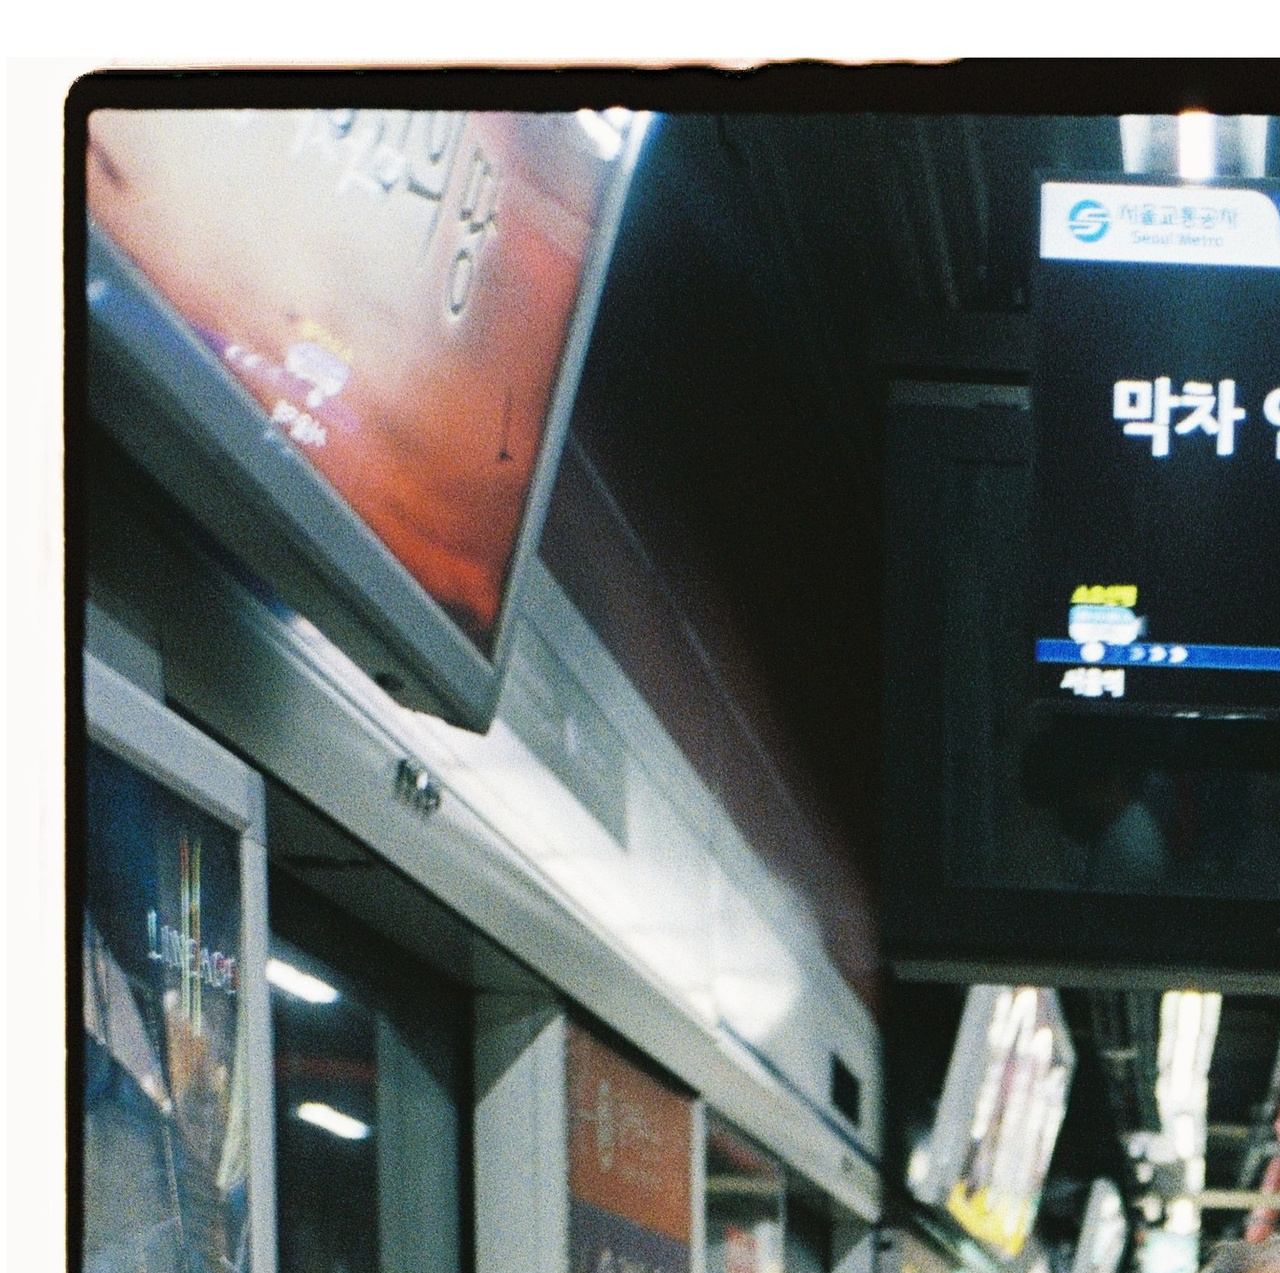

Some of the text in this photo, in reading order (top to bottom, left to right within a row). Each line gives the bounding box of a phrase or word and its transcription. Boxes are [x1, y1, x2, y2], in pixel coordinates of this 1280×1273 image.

[1117, 203, 1239, 229] 서울교통공사
[1131, 230, 1224, 247] Seoul Metro
[1112, 376, 1246, 458] 막차
